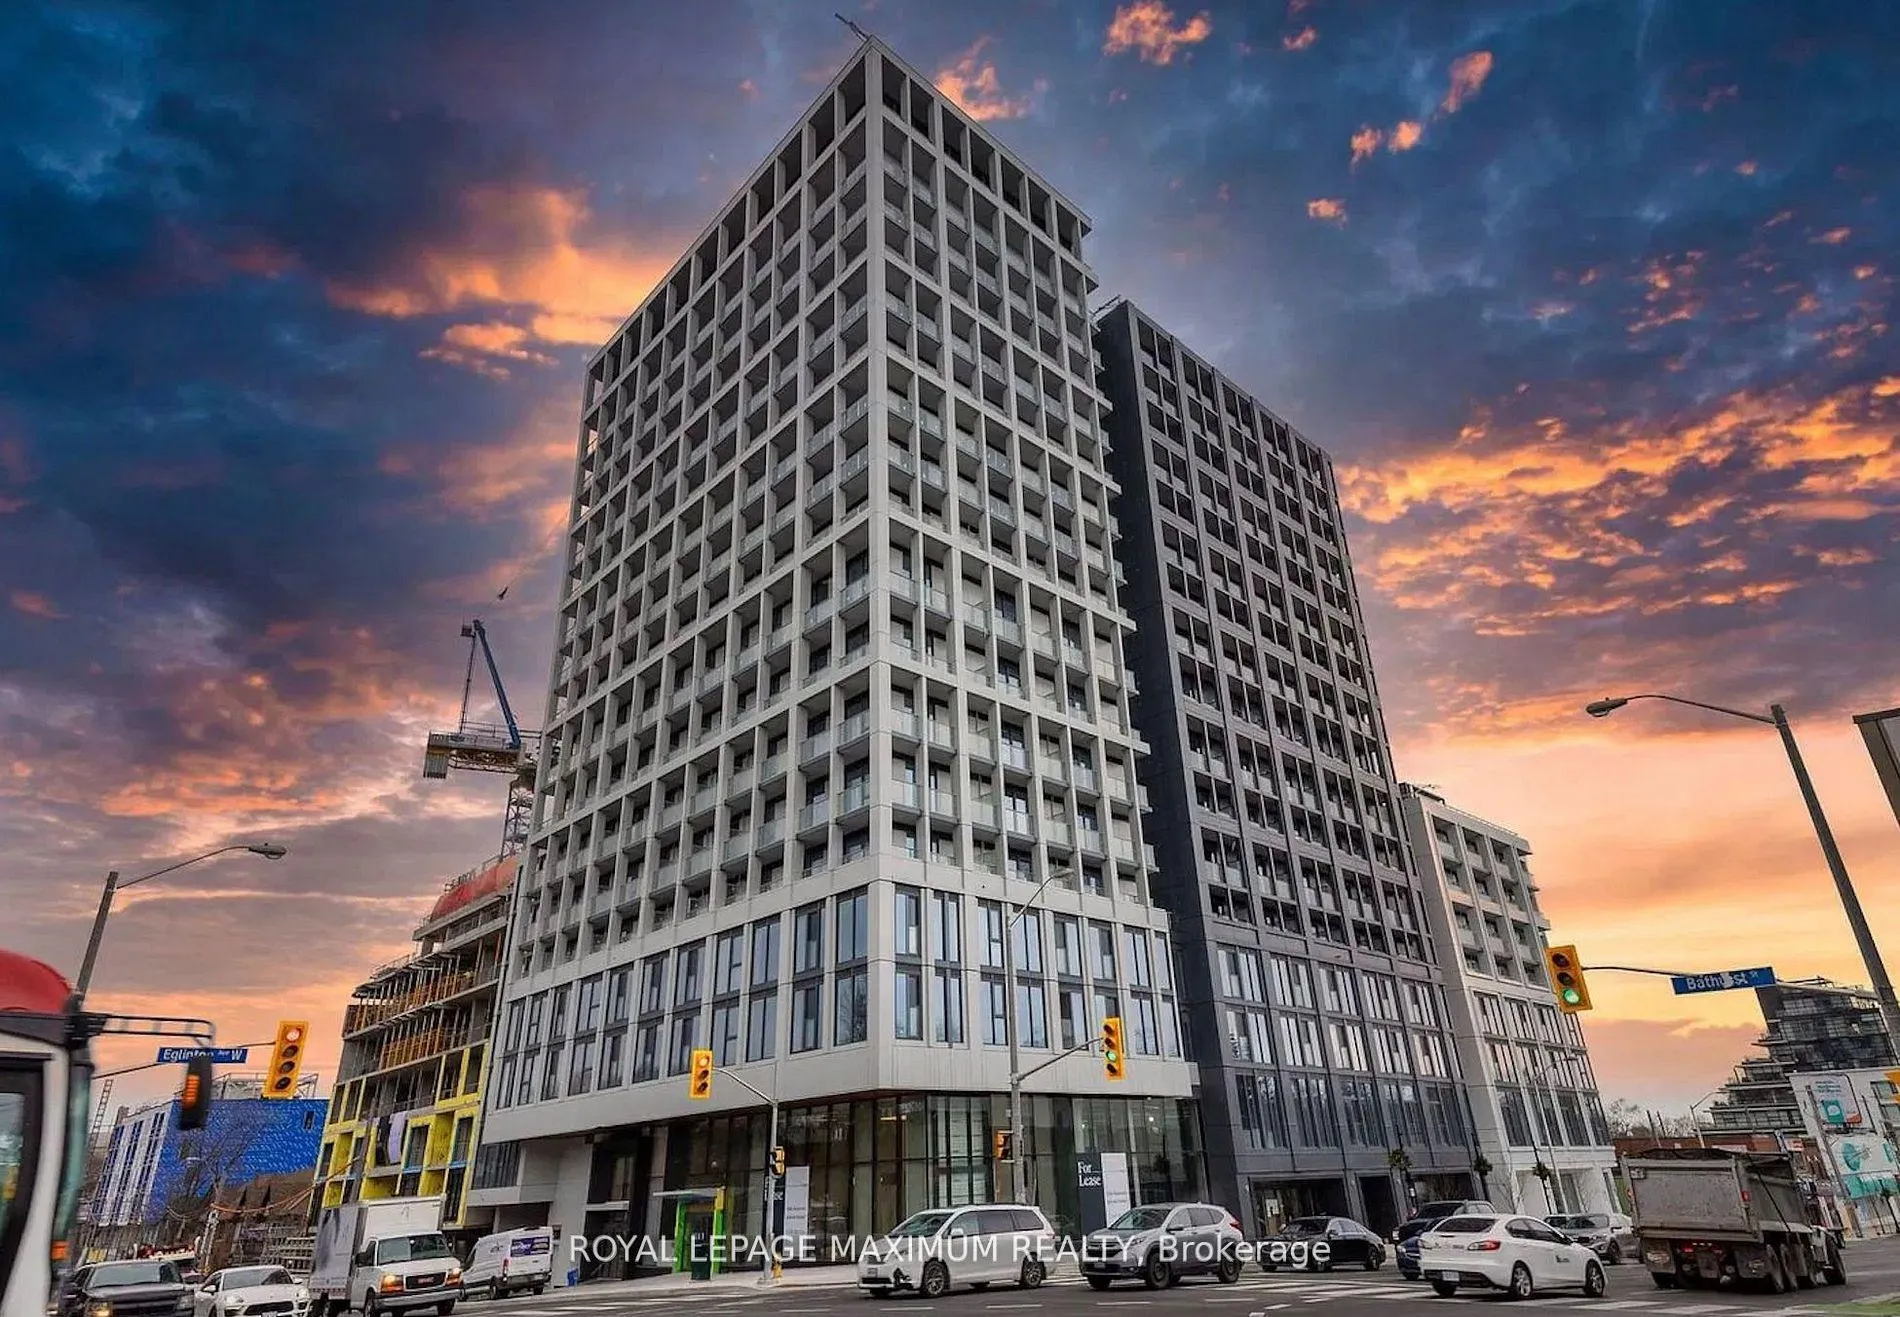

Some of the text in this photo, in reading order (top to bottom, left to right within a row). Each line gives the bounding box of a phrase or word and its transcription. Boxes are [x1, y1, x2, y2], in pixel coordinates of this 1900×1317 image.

[231, 1049, 243, 1060] W
[1078, 1160, 1091, 1173] For
[1078, 1174, 1101, 1187] Lease
